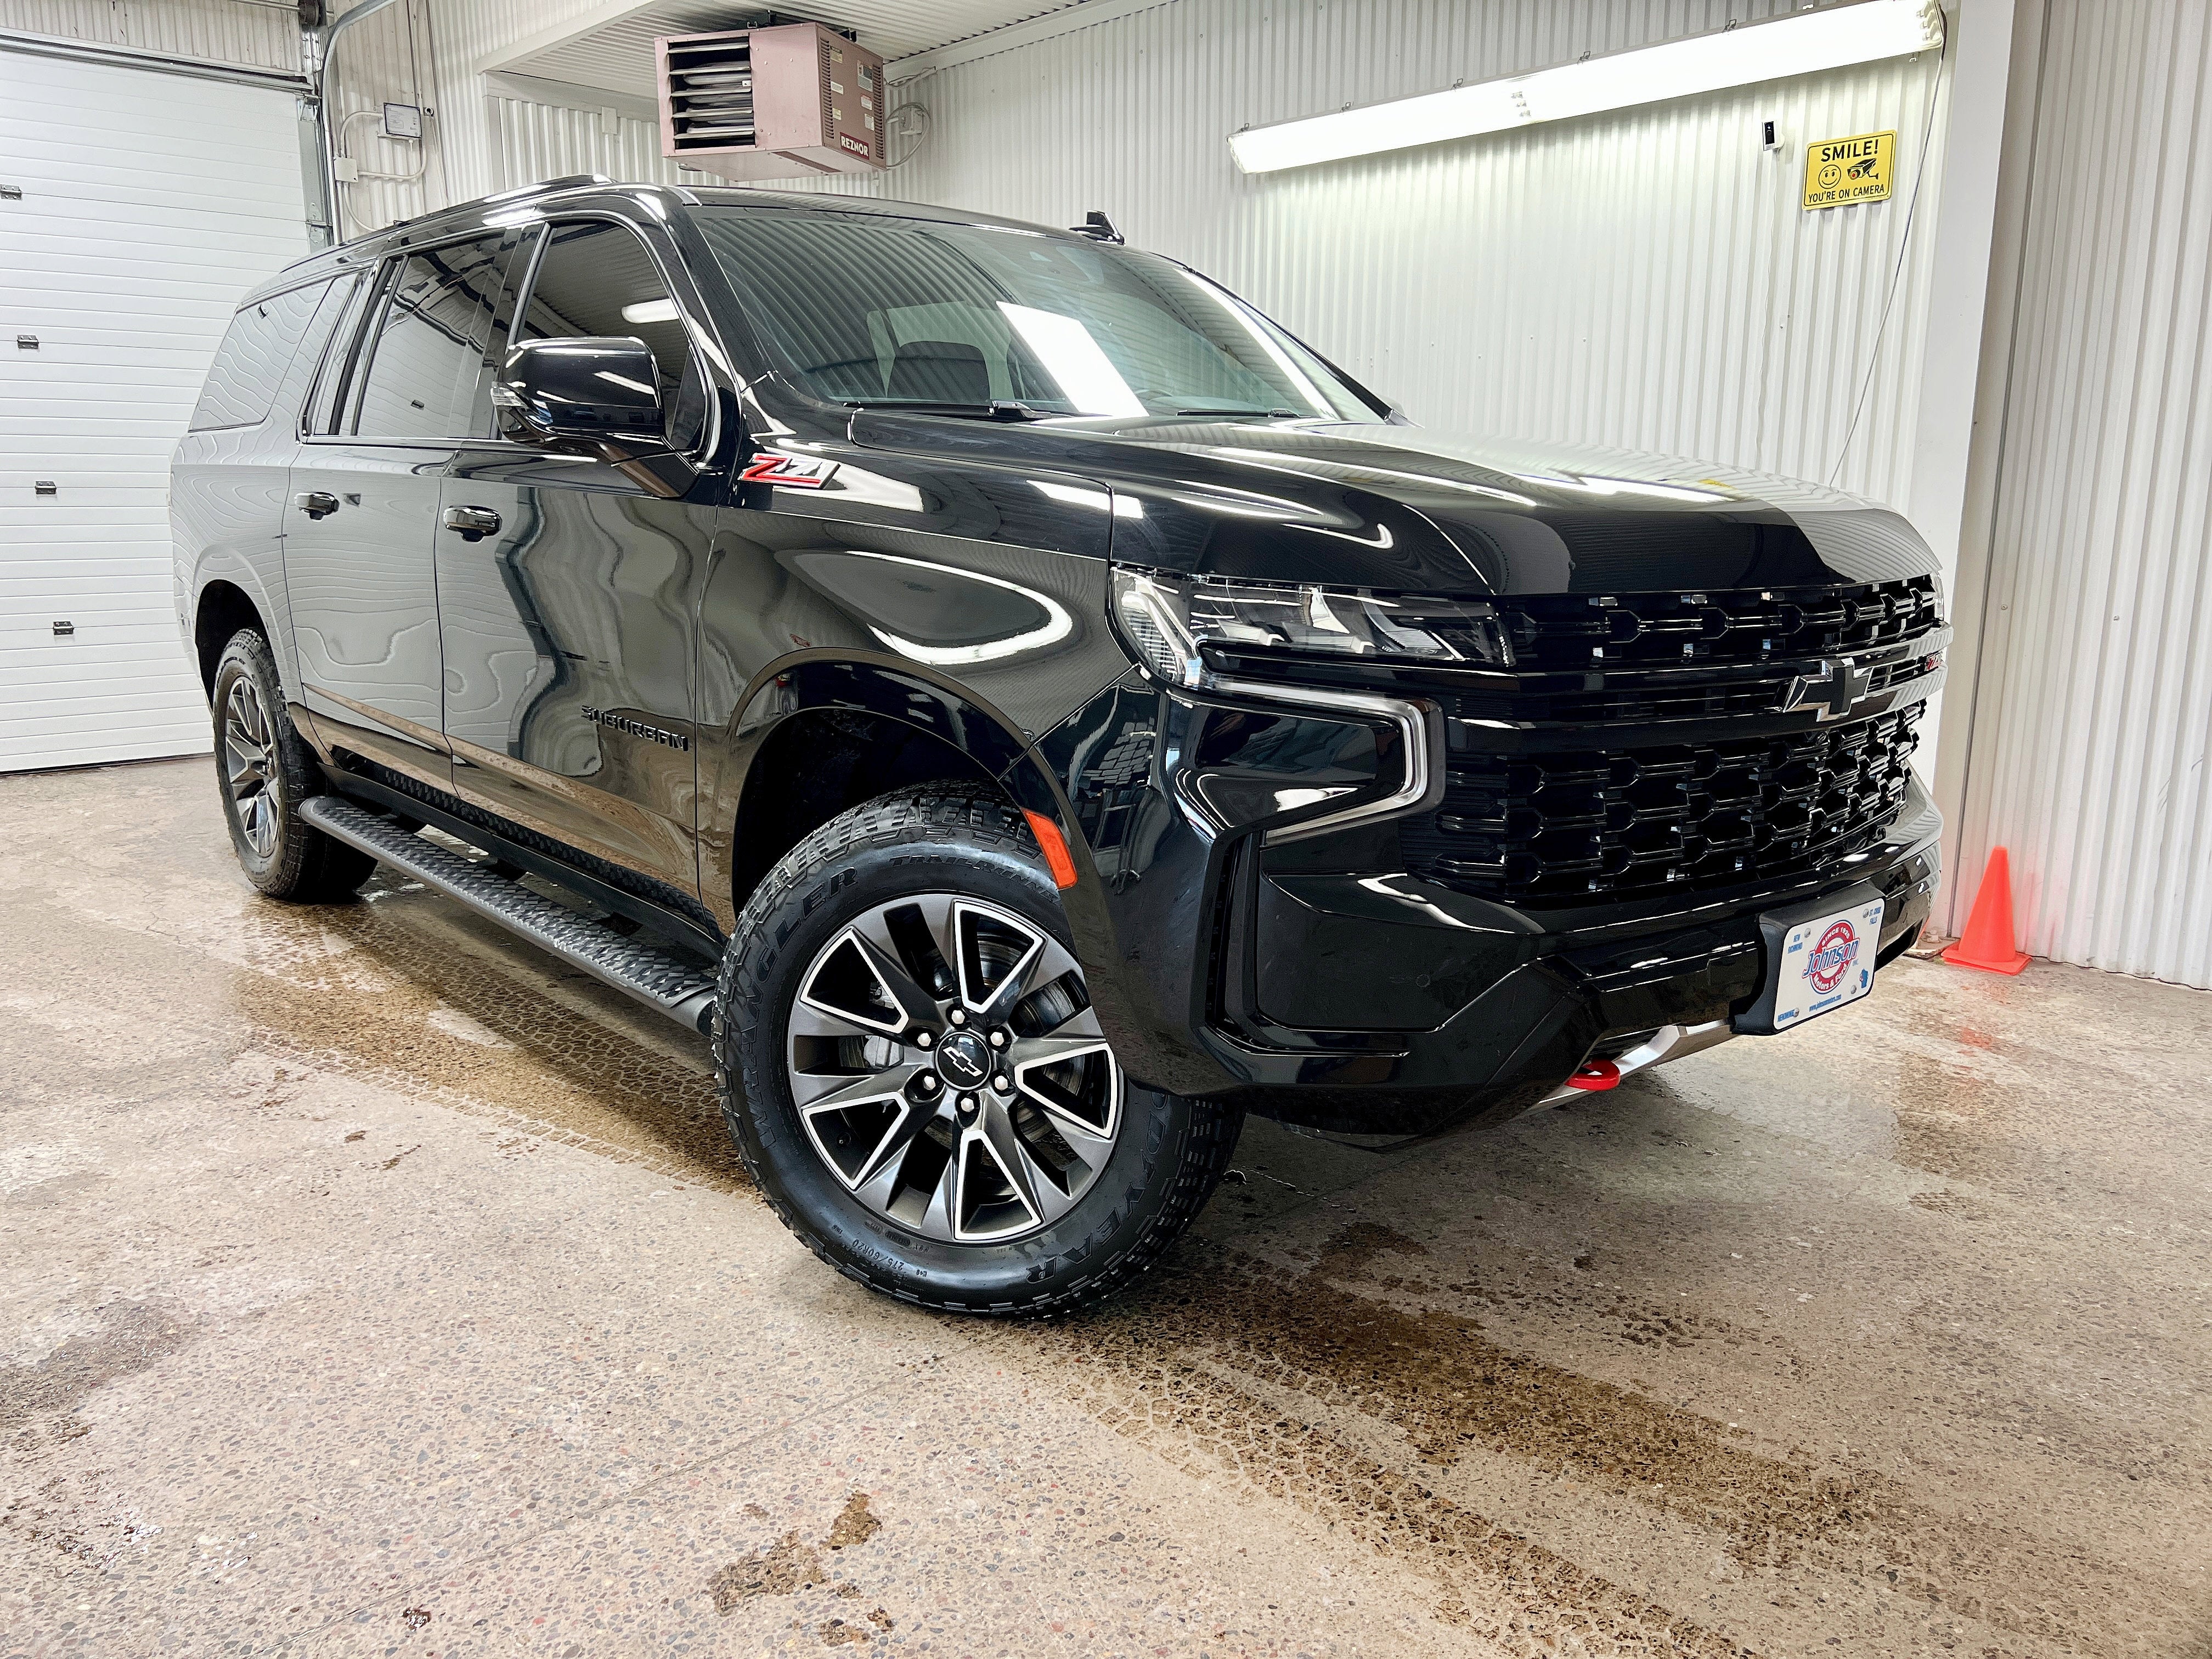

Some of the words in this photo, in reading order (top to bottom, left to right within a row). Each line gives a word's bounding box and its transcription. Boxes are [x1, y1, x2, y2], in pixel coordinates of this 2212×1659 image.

[840, 136, 869, 158] REZNOR
[1820, 139, 1879, 162] SMILE!
[1808, 190, 1836, 204] YOU'RE
[1838, 189, 1850, 199] ON
[1853, 184, 1884, 197] CAMERA
[737, 452, 841, 489] Z71
[580, 705, 690, 752] SUBURBAN
[889, 854, 1062, 904] TRAILRUNNE
[1821, 927, 1839, 946] SINCE
[1802, 938, 1860, 977] Johnson
[1813, 974, 1830, 990] Motors
[1830, 978, 1835, 987] &
[1835, 962, 1848, 983] Ford
[851, 1239, 905, 1272] 275/60R20
